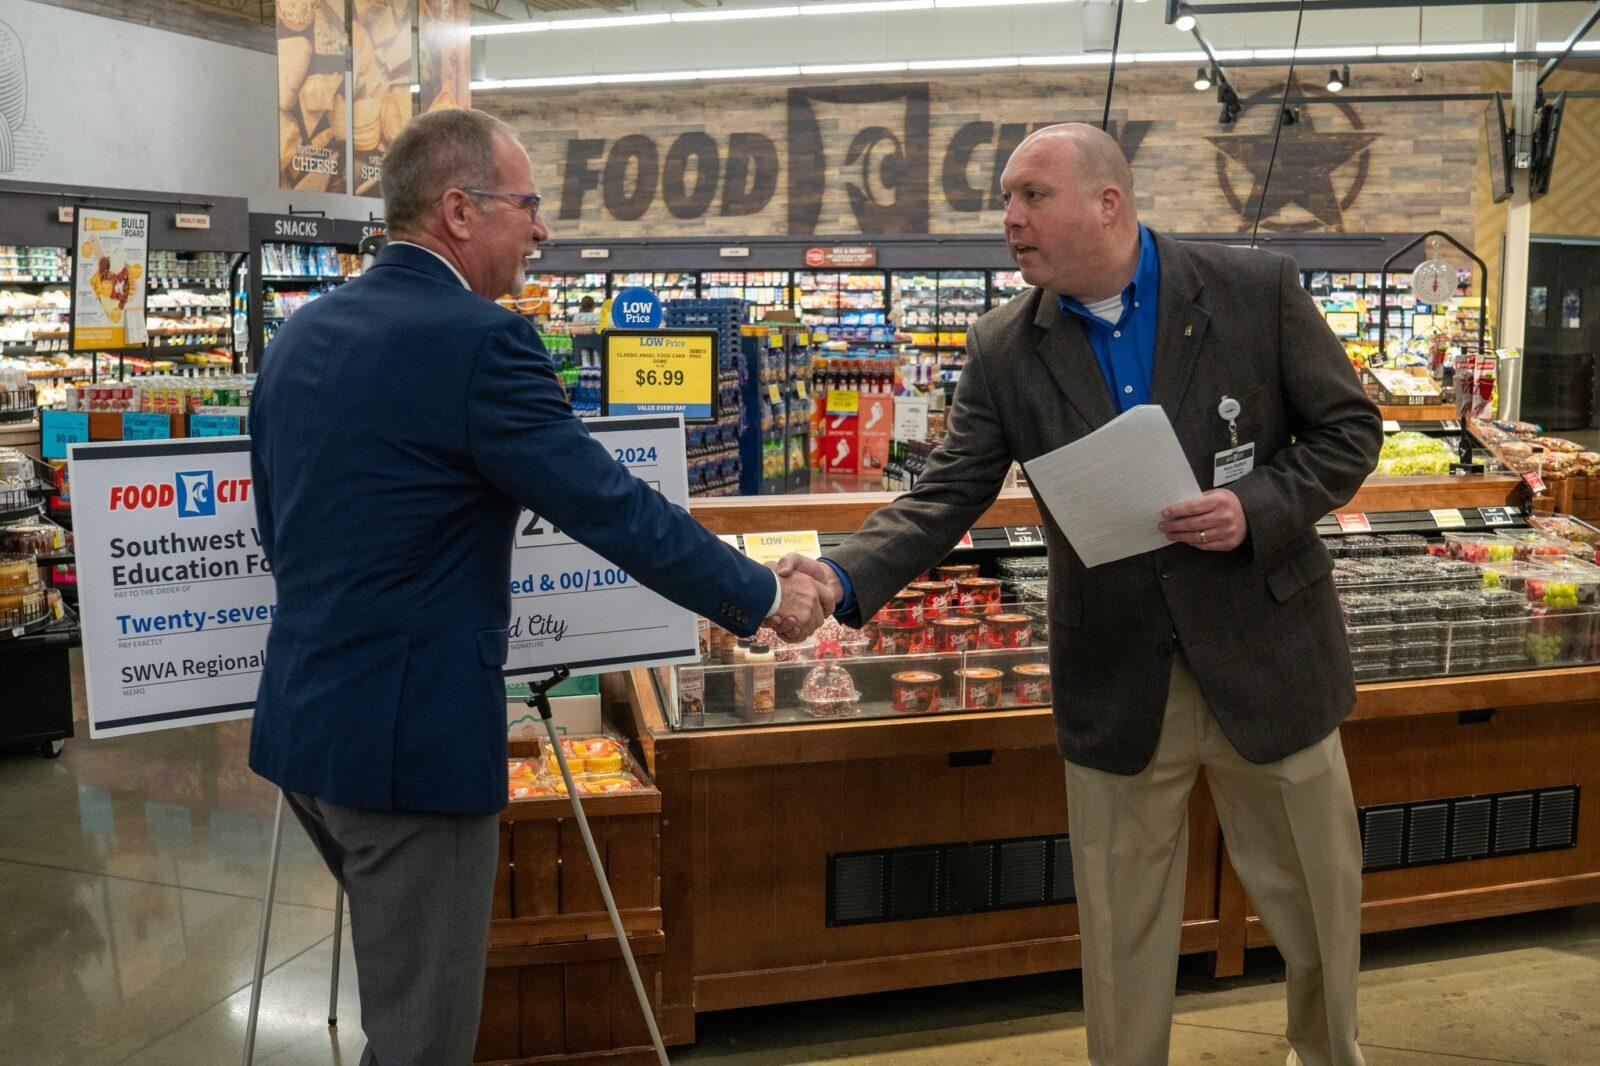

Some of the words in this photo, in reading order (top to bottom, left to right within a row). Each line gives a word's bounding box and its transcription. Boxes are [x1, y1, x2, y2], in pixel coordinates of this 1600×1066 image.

[292, 156, 338, 175] CHEESE
[558, 131, 779, 221] FOOD
[942, 120, 1155, 212] CIY
[121, 217, 145, 230] BUILD
[275, 220, 317, 237] SNACKS
[124, 229, 145, 238] BOARD
[622, 302, 653, 314] LOW
[625, 313, 650, 323] Price
[640, 337, 664, 347] LOW
[665, 339, 686, 347] Price
[635, 369, 684, 387] $6.99
[55, 434, 77, 443] $0.89
[614, 446, 658, 463] 2024
[109, 483, 175, 511] FOOD
[216, 478, 252, 504] CIT
[109, 529, 246, 558] Southwest
[760, 537, 782, 546] LOW
[784, 536, 802, 545] Price
[112, 557, 239, 587] Education
[246, 554, 272, 574] Fo
[510, 574, 534, 594] ed
[539, 573, 555, 591] &
[560, 569, 628, 592] 00/100
[114, 591, 128, 599] PAY
[156, 586, 180, 595] ORDER
[508, 616, 522, 638] d
[528, 614, 568, 641] City
[119, 641, 132, 649] PAY
[134, 638, 163, 648] EXACTLY
[510, 641, 544, 649] SIGNATURE
[121, 662, 178, 683] SWVA
[182, 650, 265, 677] Regional
[122, 687, 145, 697] MEMO
